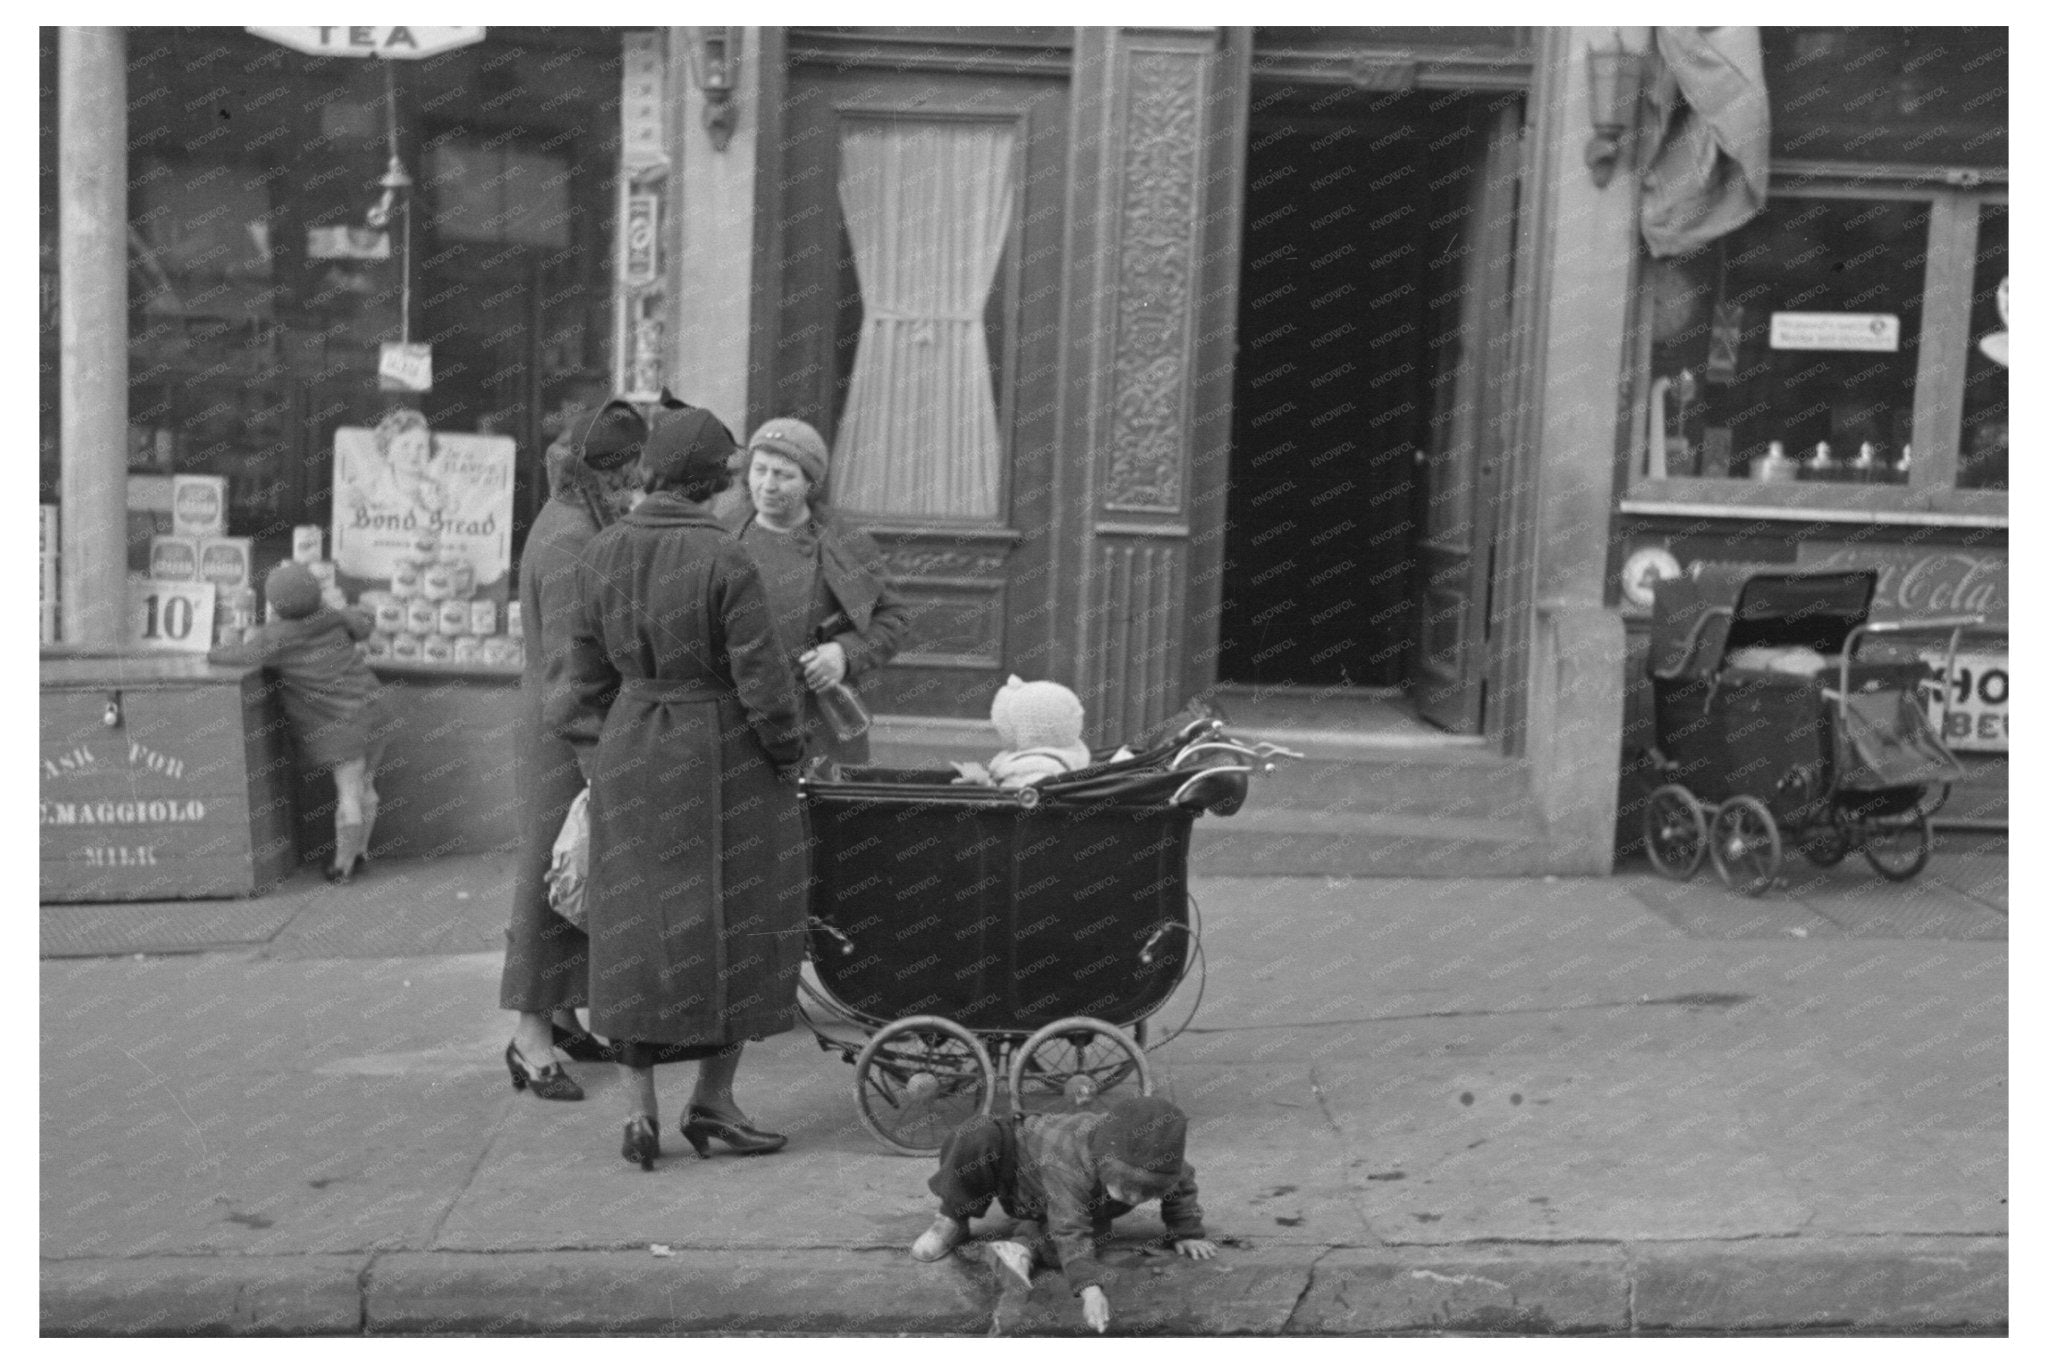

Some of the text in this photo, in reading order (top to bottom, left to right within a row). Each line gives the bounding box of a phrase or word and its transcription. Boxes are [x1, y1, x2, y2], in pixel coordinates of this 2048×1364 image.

[310, 26, 417, 48] TEA
[350, 504, 496, 536] Bond Bread
[1898, 553, 1996, 610] Cola
[1946, 712, 2008, 740] BE
[44, 743, 184, 780] ASK FOR
[85, 845, 157, 867] MILK
